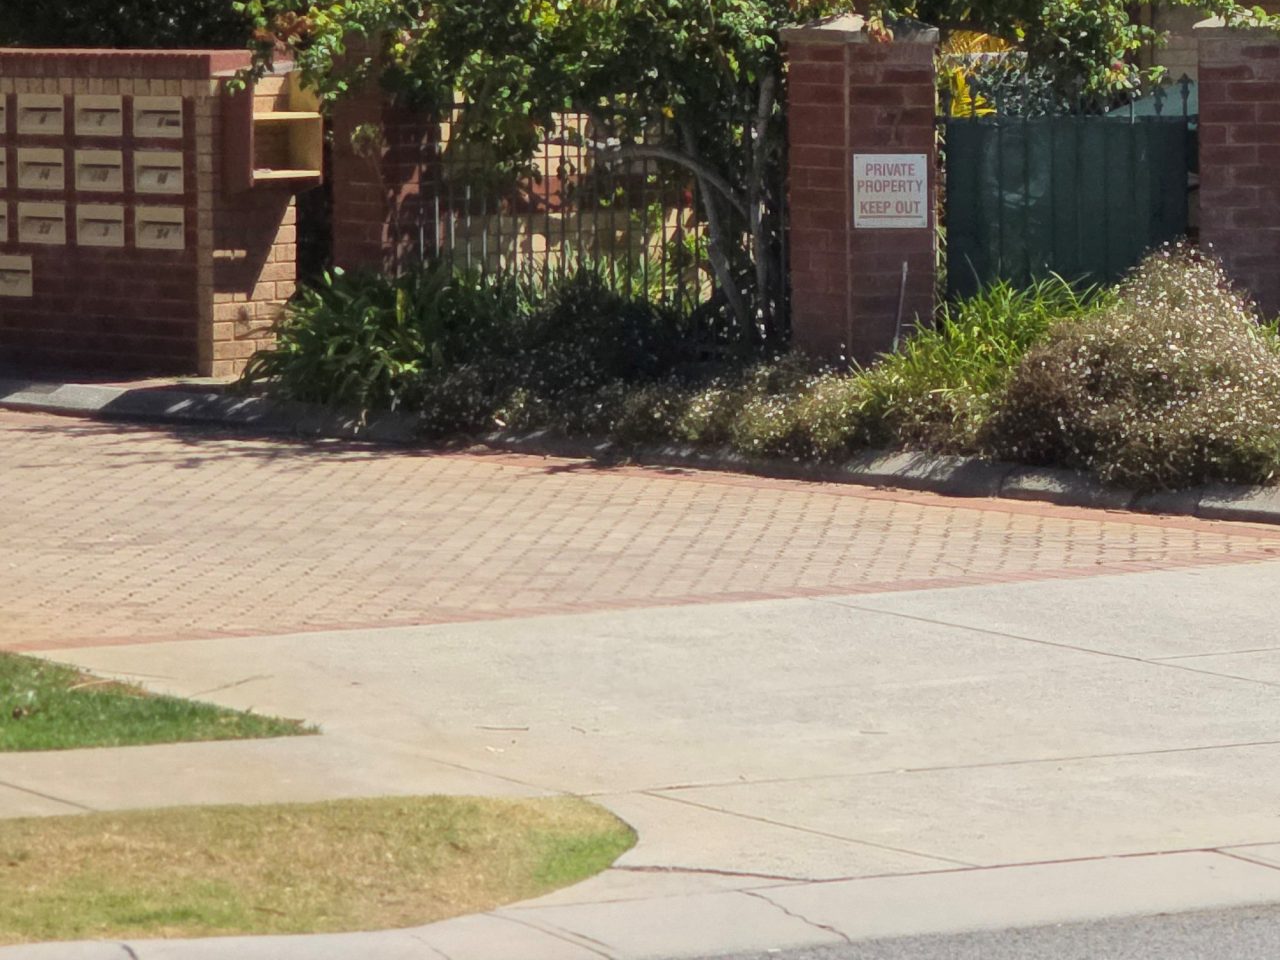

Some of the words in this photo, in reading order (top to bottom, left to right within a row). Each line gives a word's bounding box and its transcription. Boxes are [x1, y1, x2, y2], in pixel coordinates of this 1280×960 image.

[865, 163, 915, 176] PRIVATE
[857, 180, 923, 193] PROPERTY
[860, 201, 891, 214] KEEP
[895, 201, 920, 214] OUT
